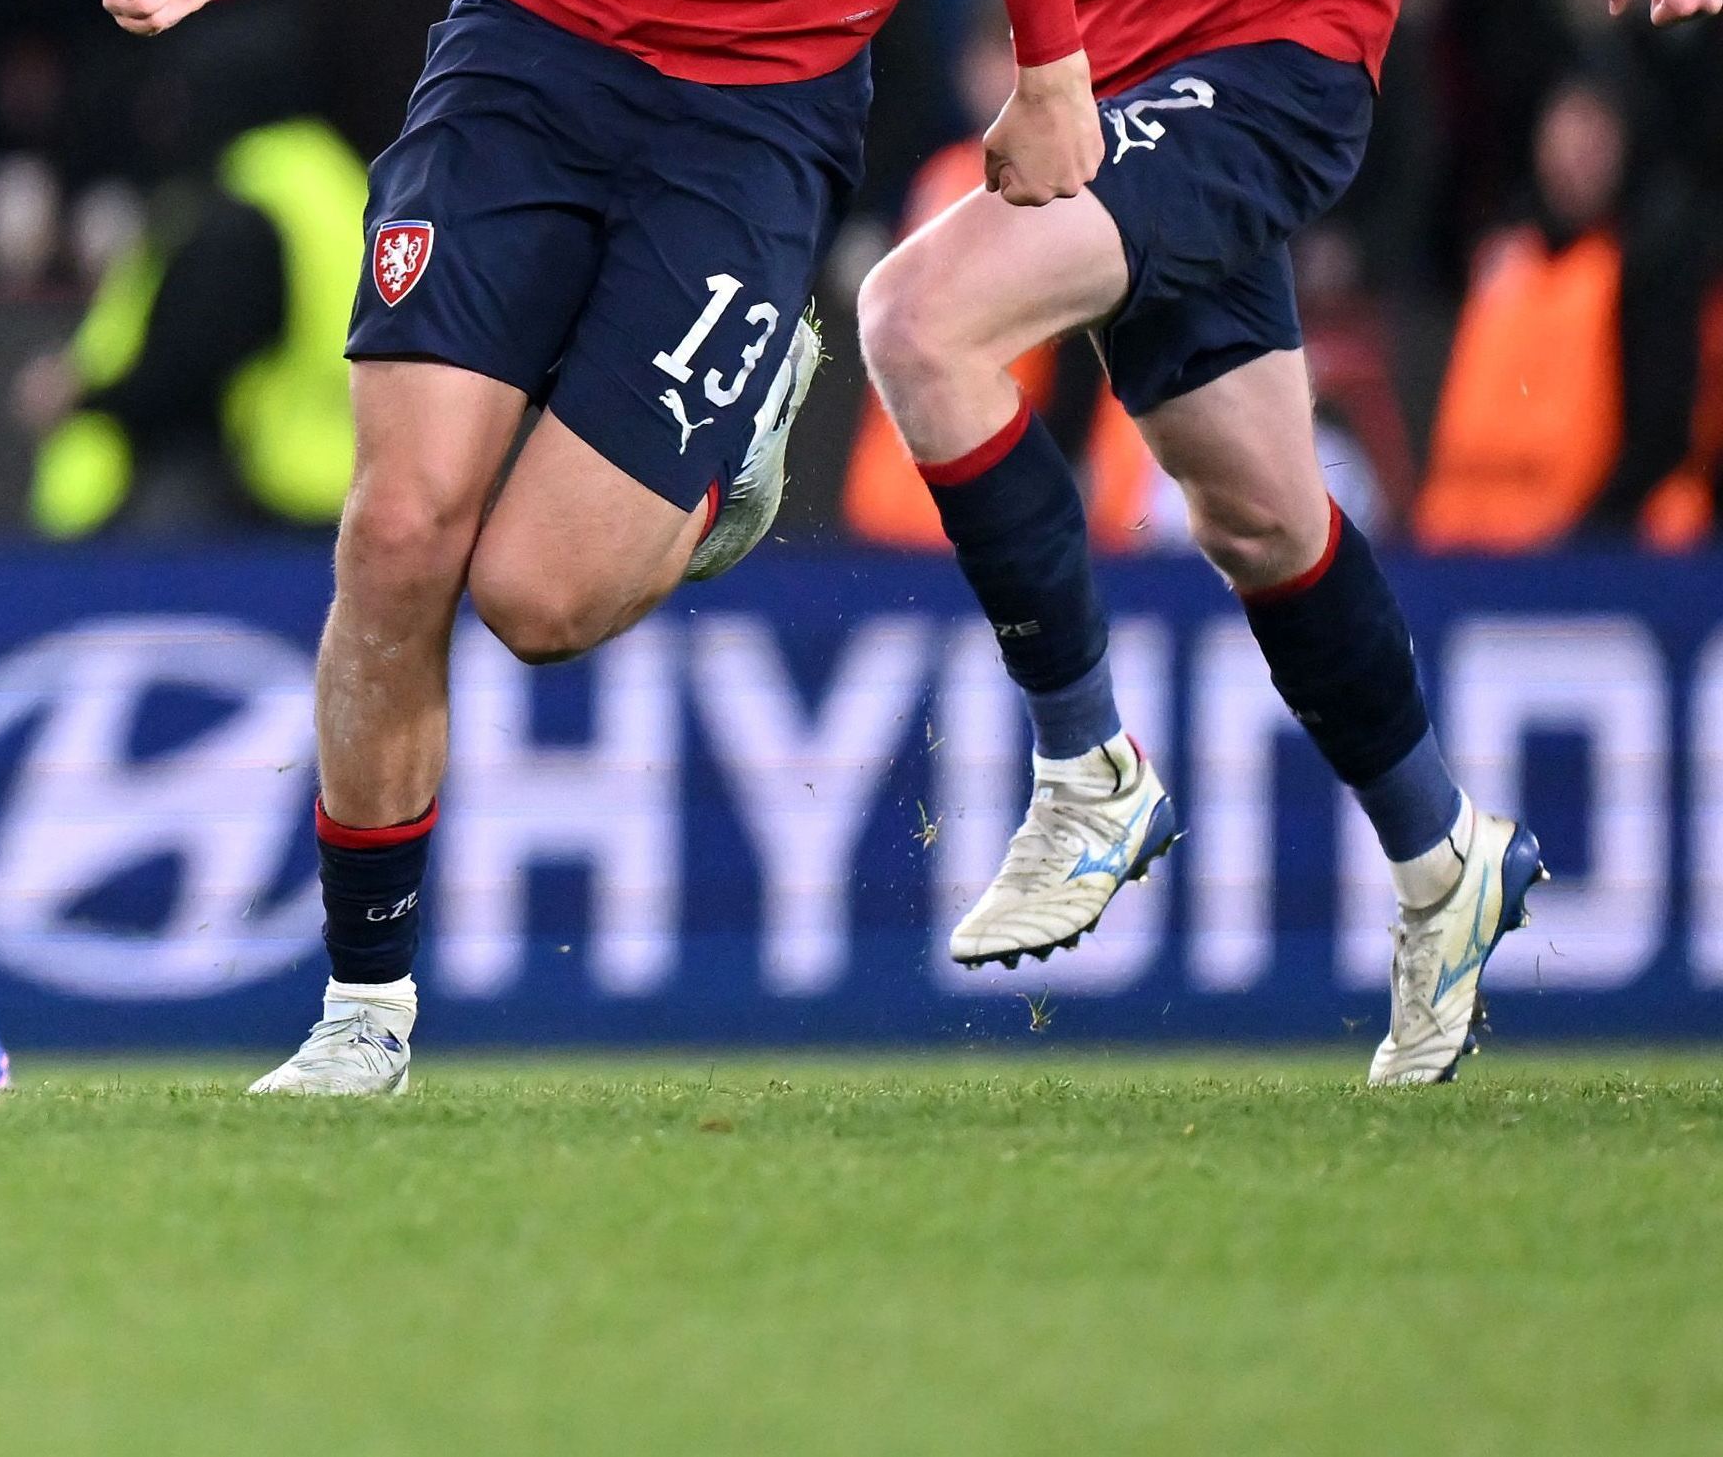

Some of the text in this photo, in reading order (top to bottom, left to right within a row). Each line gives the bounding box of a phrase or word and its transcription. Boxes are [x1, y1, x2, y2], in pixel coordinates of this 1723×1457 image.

[1123, 77, 1216, 141] 2
[652, 274, 779, 407] 13
[993, 620, 1043, 637] ZE
[440, 614, 1723, 996] HYUND
[365, 888, 419, 922] CZE
